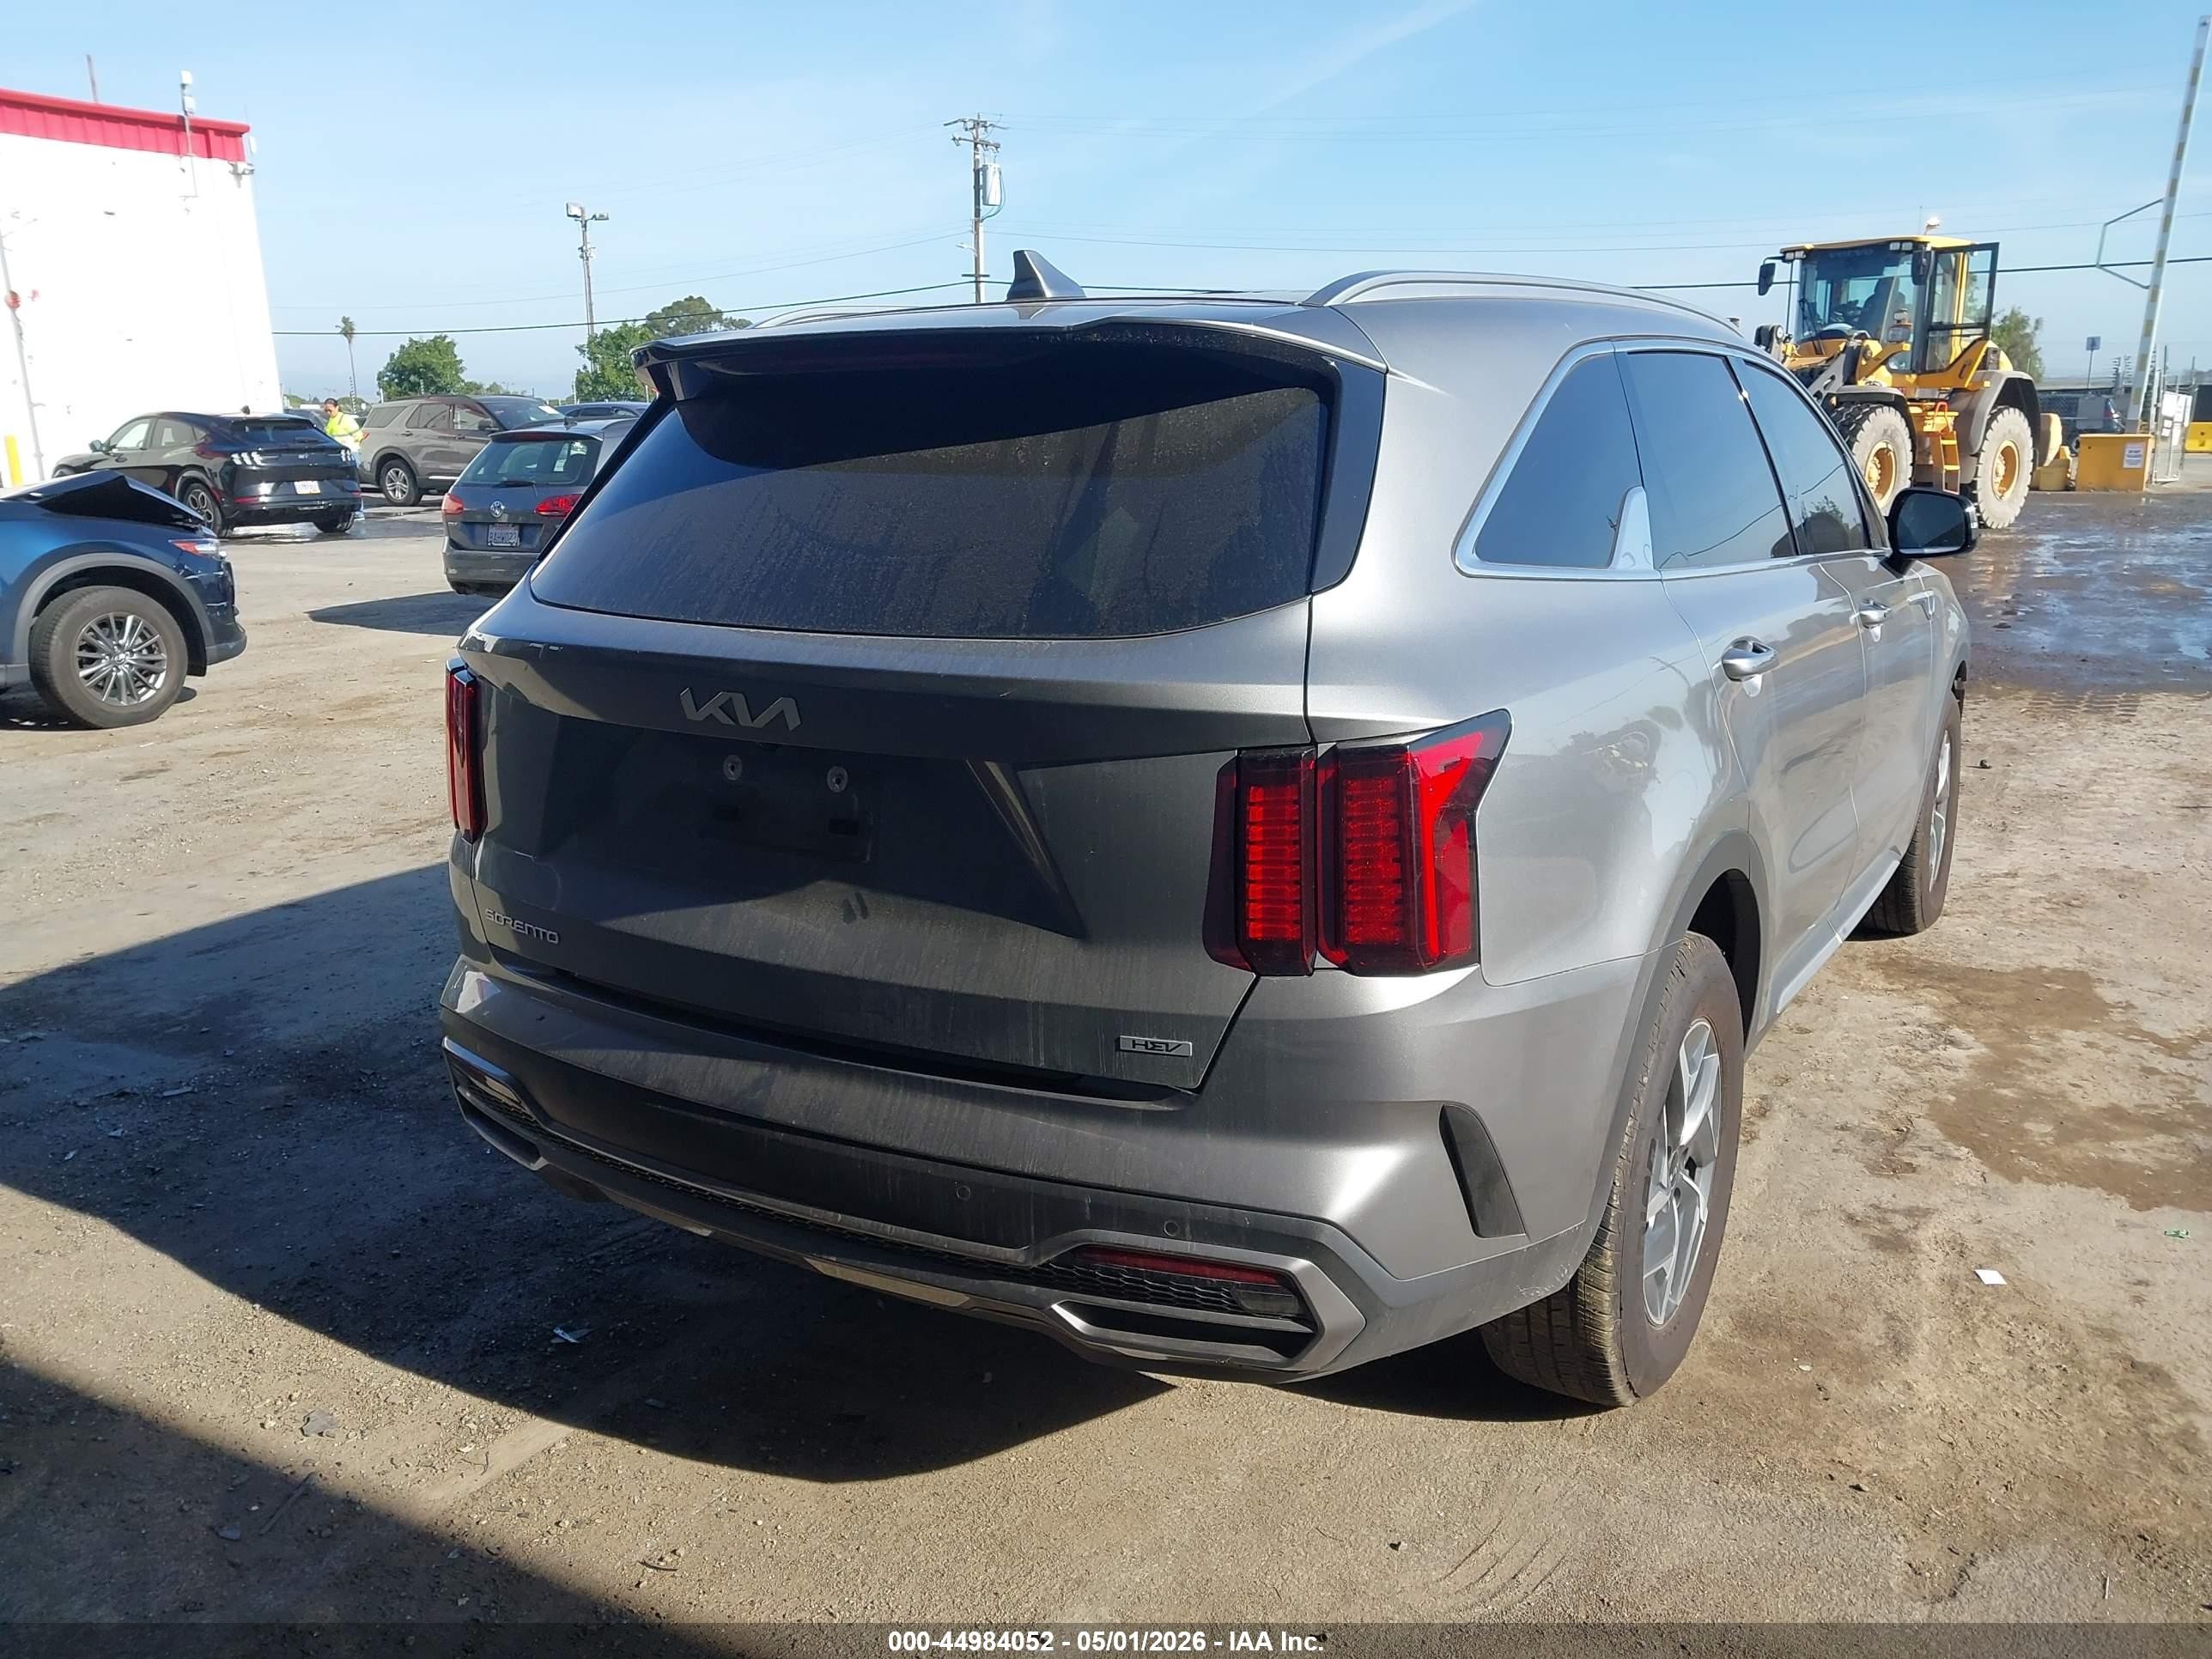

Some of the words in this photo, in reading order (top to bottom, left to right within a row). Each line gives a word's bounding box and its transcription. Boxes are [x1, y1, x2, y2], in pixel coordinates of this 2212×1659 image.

[679, 687, 802, 732] KIA
[485, 908, 559, 945] SORENTO
[1132, 1038, 1182, 1053] HEV
